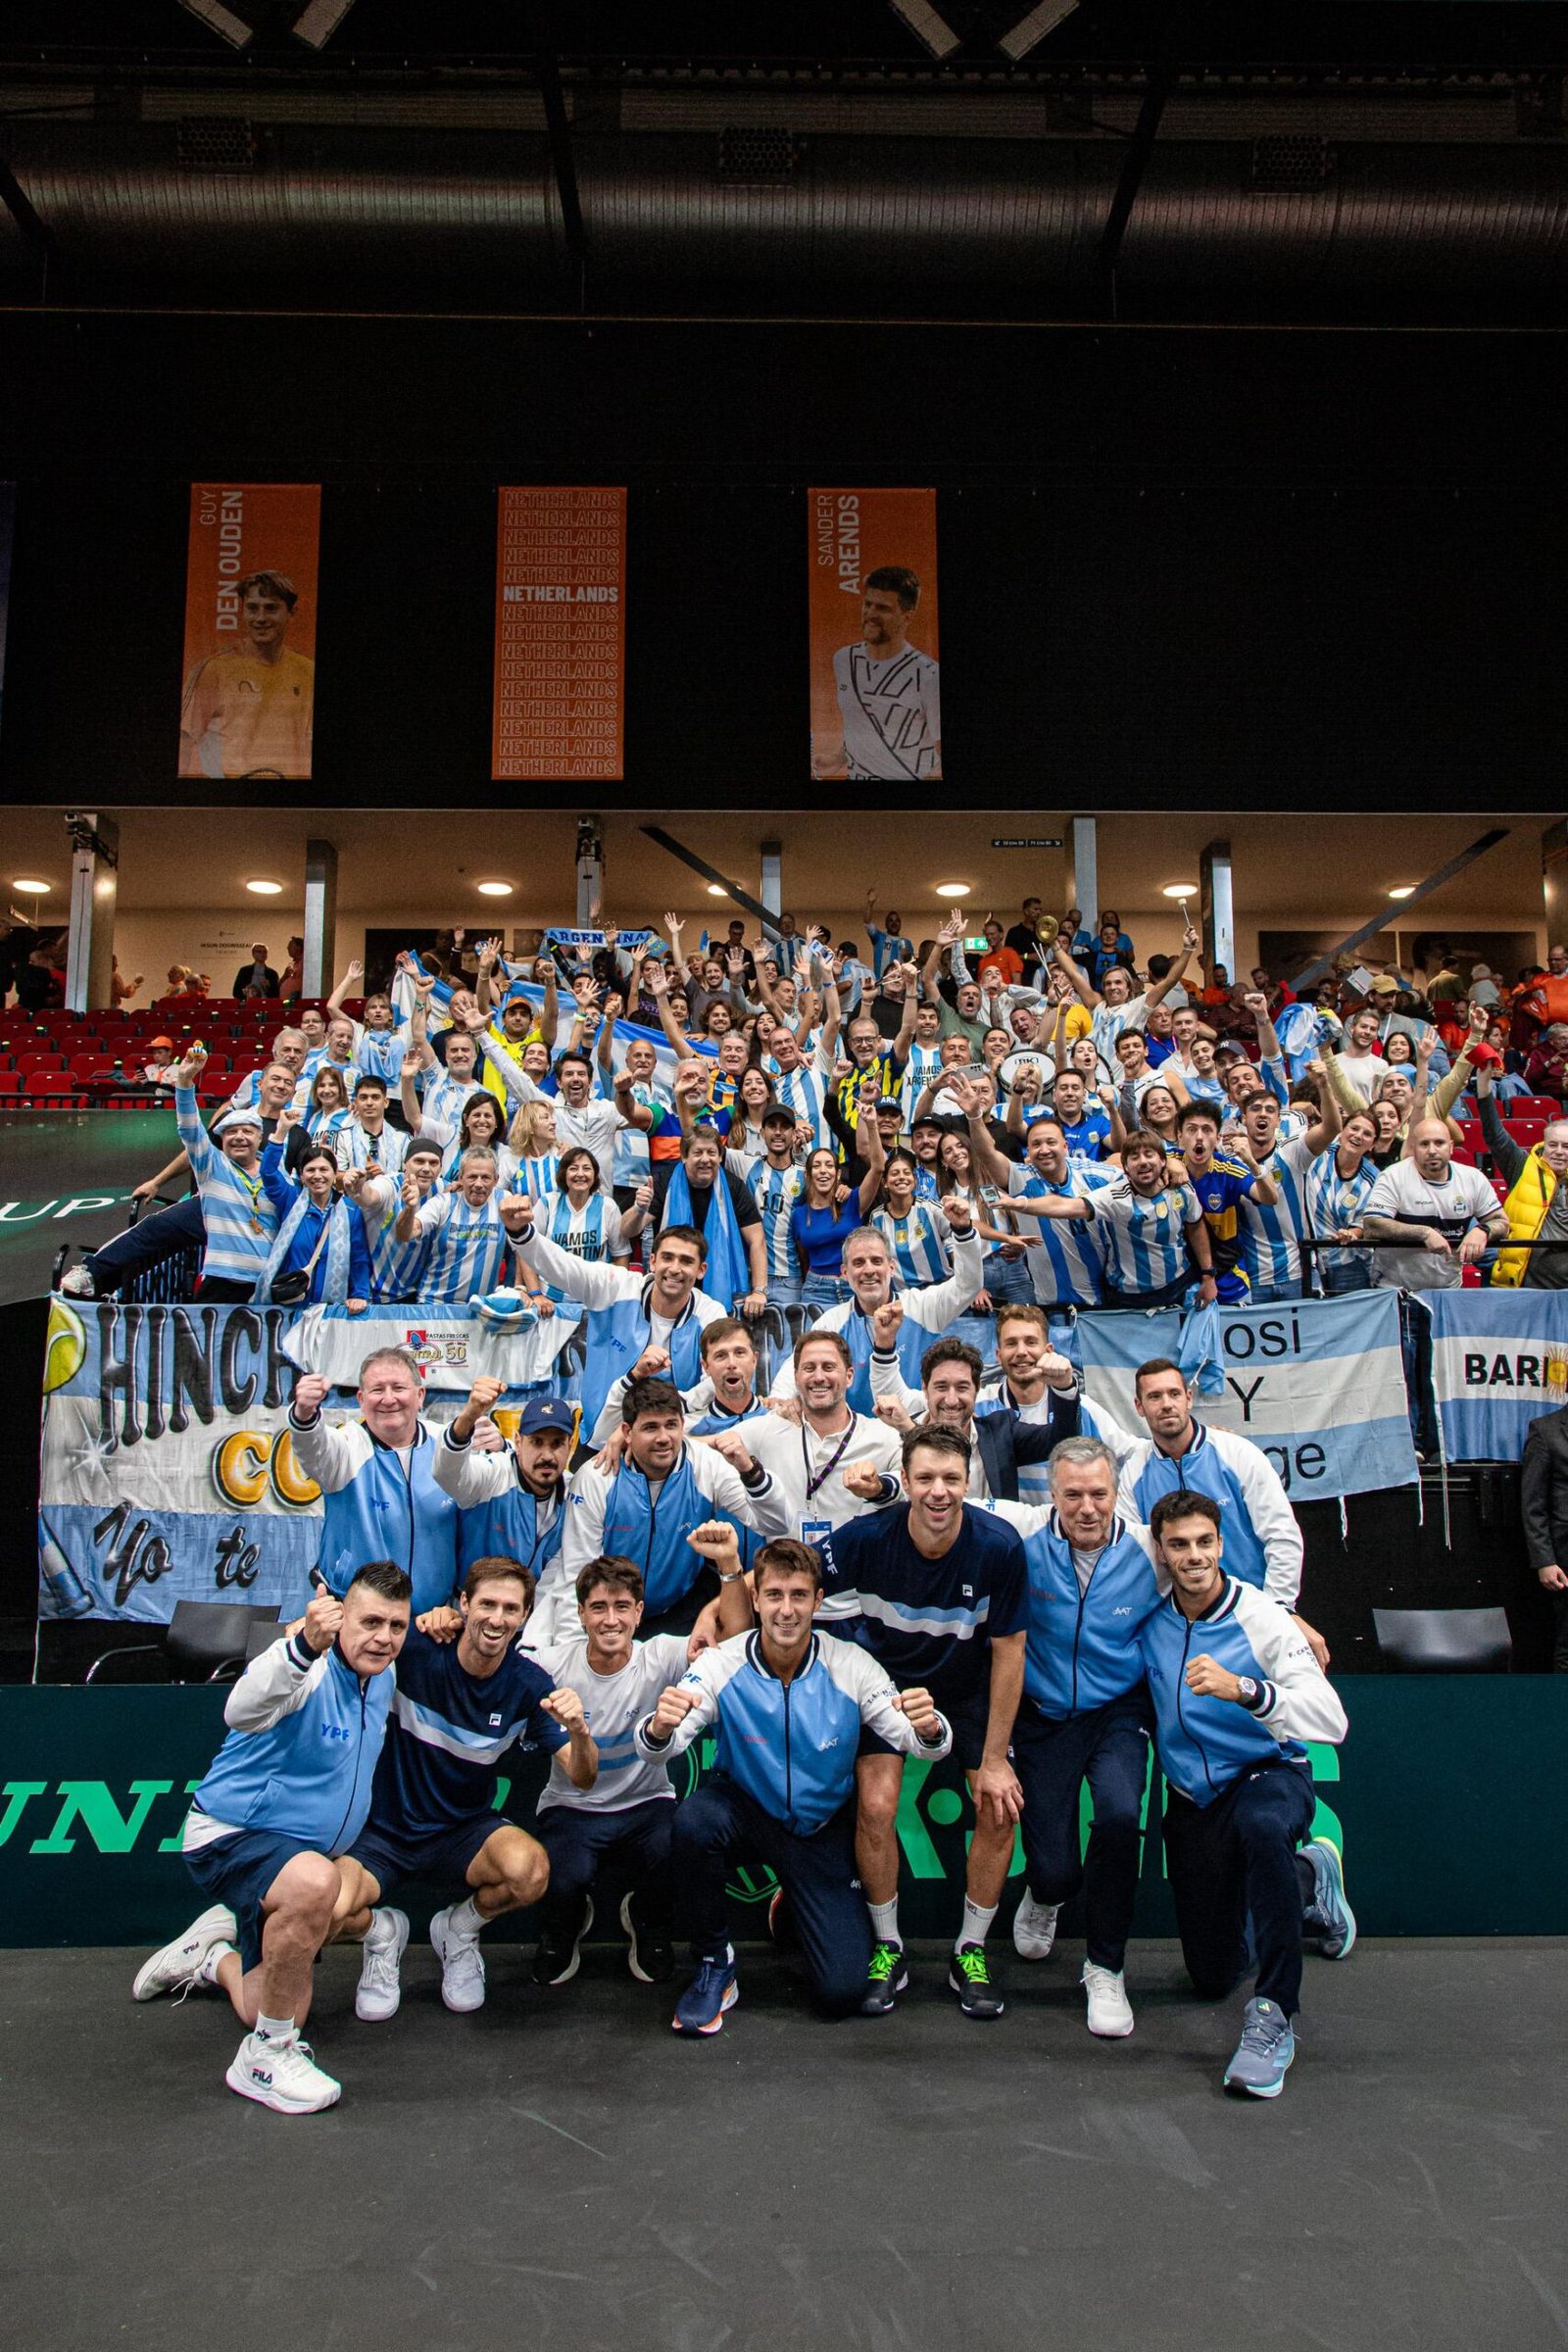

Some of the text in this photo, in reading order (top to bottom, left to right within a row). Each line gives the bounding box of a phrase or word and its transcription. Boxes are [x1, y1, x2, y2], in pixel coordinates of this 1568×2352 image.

[200, 490, 217, 526] GUY
[505, 492, 619, 509] NETHERLANDS
[505, 511, 619, 527] NETHERLANDS
[504, 530, 619, 547] NETHERLANDS
[817, 494, 834, 566] SANDER
[838, 494, 860, 595] ARENDS
[217, 490, 243, 630] DEN OUDEN
[504, 549, 618, 565] NETHERLANDS
[503, 568, 618, 585] NETHERLANDS
[504, 587, 618, 603] NETHERLANDS
[502, 606, 618, 622] NETHERLANDS
[502, 625, 618, 642] NETHERLANDS
[502, 644, 618, 661] NETHERLANDS
[501, 663, 617, 680] NETHERLANDS
[501, 682, 617, 699] NETHERLANDS
[500, 701, 617, 717] NETHERLANDS
[500, 720, 617, 737] NETHERLANDS
[499, 739, 617, 756] NETHERLANDS
[499, 759, 617, 775] NETHERLANDS
[550, 930, 647, 945] ARGENINA
[880, 1096, 897, 1104] ARG
[760, 1190, 785, 1214] 10
[555, 1230, 597, 1248] VAMOS
[446, 1346, 466, 1361] 50
[1227, 1376, 1265, 1423] Y
[94, 1501, 261, 1606] Yo te
[822, 1540, 839, 1575] YPF
[321, 1724, 350, 1740] YPF
[252, 2068, 272, 2085] FILA
